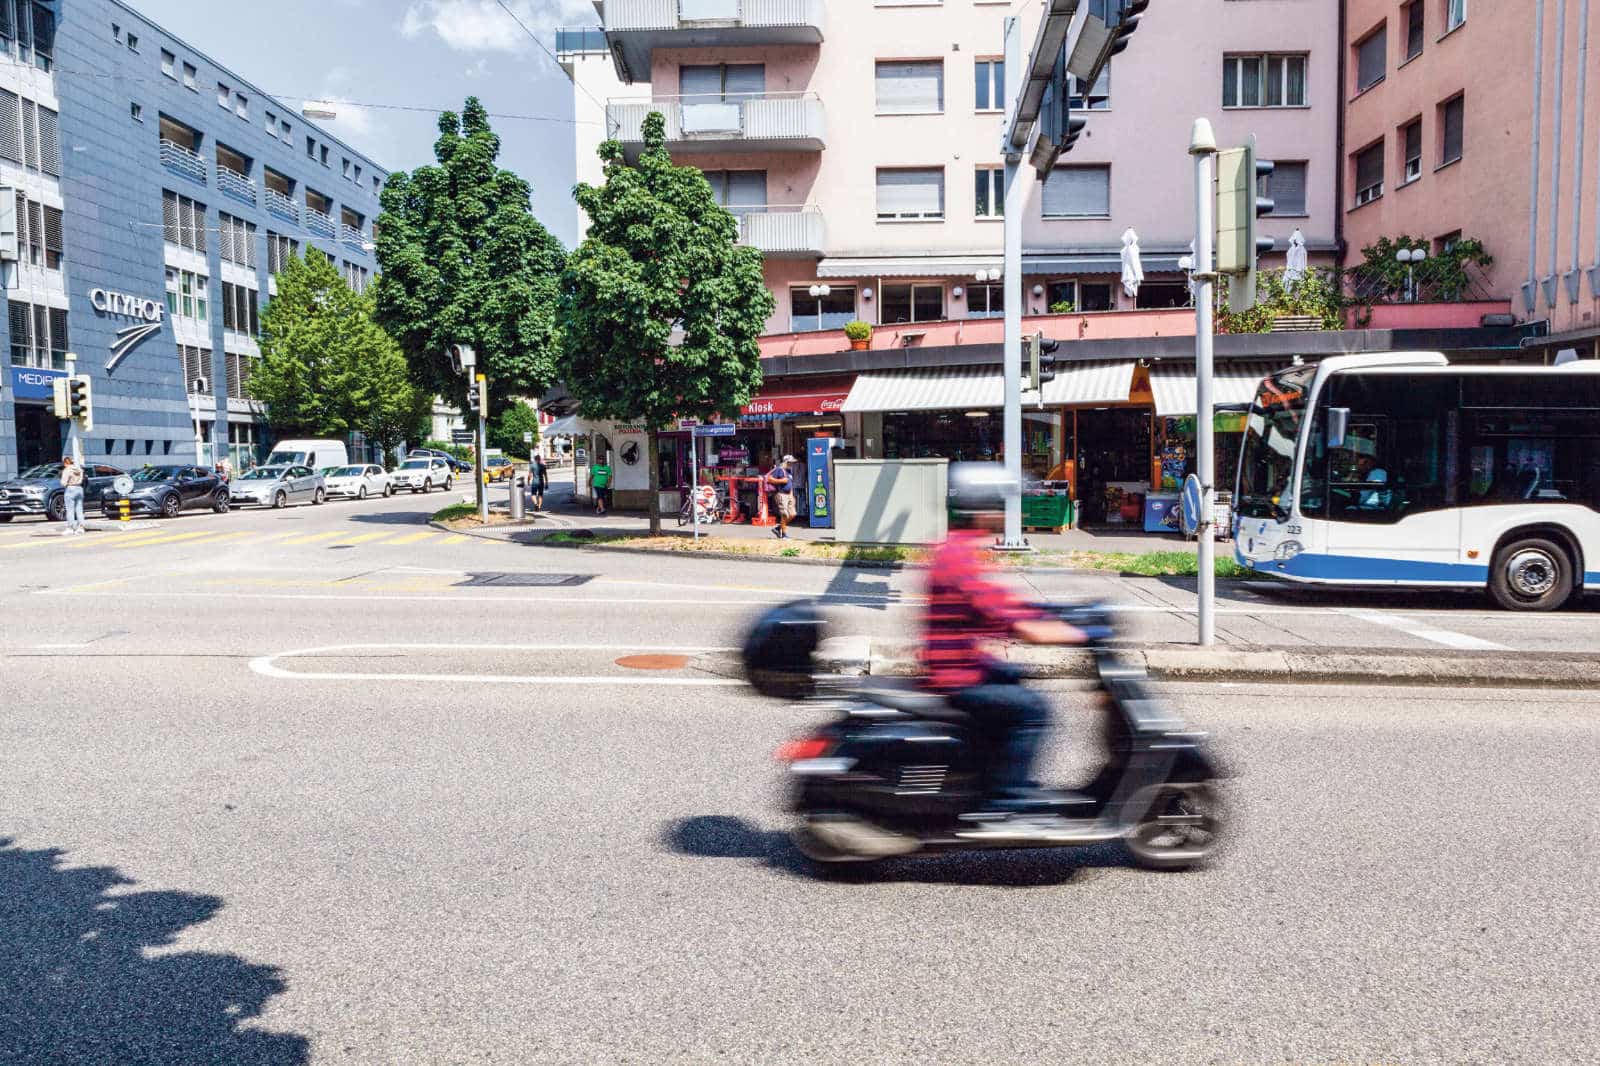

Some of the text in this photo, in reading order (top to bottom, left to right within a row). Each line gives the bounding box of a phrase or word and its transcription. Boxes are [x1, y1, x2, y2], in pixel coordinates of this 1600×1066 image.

[89, 288, 165, 322] CITYHOF
[18, 373, 57, 386] MEDIP
[748, 401, 774, 413] Kiosk
